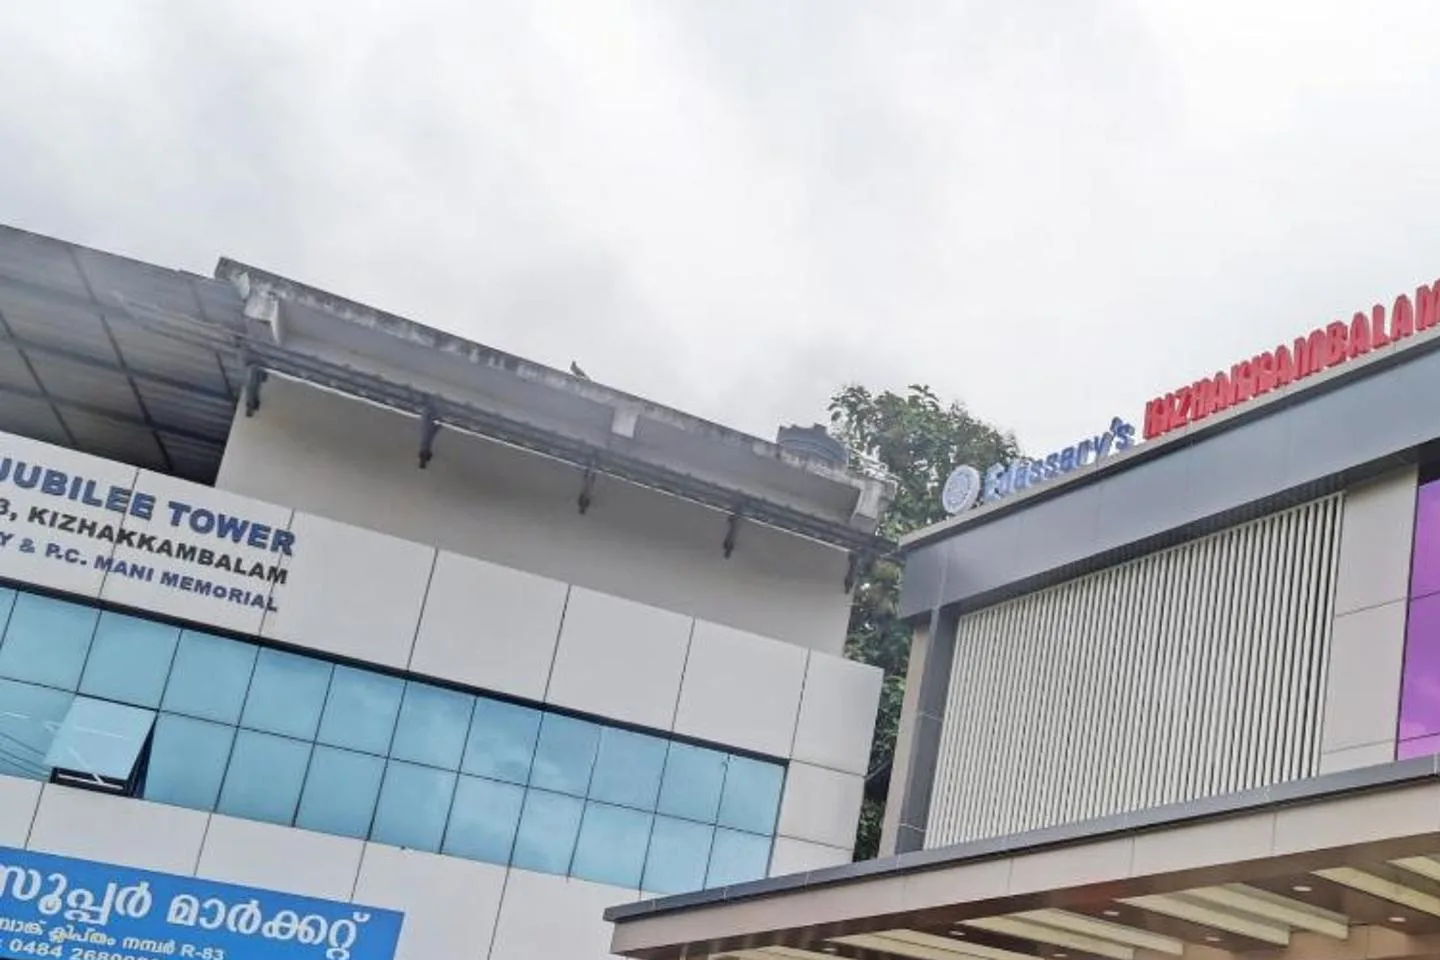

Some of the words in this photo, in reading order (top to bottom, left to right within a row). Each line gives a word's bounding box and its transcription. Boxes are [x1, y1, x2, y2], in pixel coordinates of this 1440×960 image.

[0, 458, 156, 521] JUBILEE
[168, 501, 295, 556] TOWER
[27, 506, 288, 584] KIZHAKKAMBALAM
[93, 555, 154, 582] MANI
[160, 571, 278, 612] MEMORIAL
[167, 894, 371, 960] മാർക്കറ്റ്
